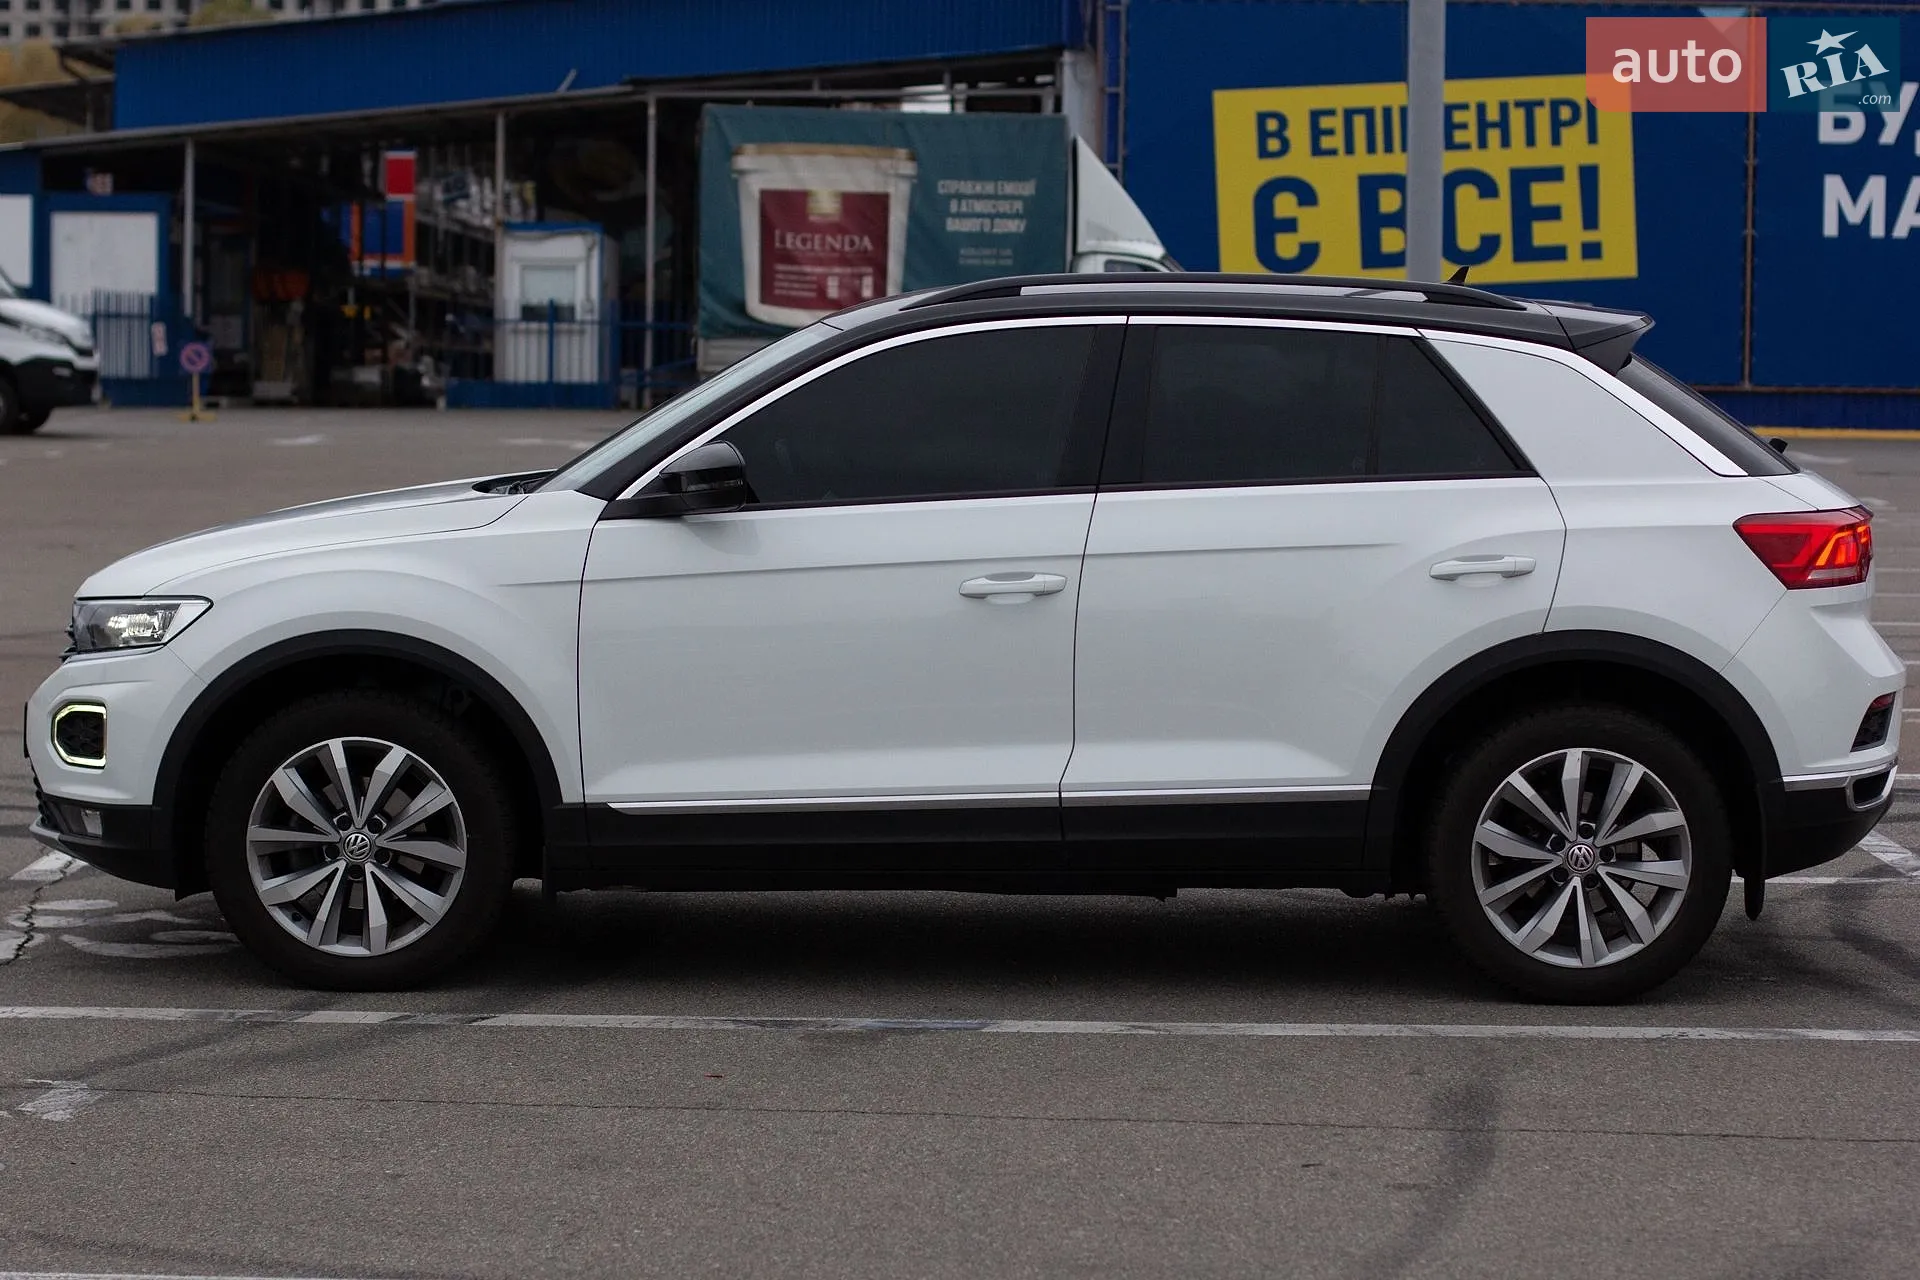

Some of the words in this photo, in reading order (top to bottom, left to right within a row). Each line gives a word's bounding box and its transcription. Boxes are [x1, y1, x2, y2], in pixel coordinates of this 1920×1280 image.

[1256, 111, 1290, 159] В
[1309, 97, 1599, 157] ЕПІЕНТРІ
[1817, 80, 1920, 156] БУ
[775, 229, 874, 252] LEGENDA
[1253, 175, 1320, 273] Є
[1357, 164, 1603, 270] ВСЕ!
